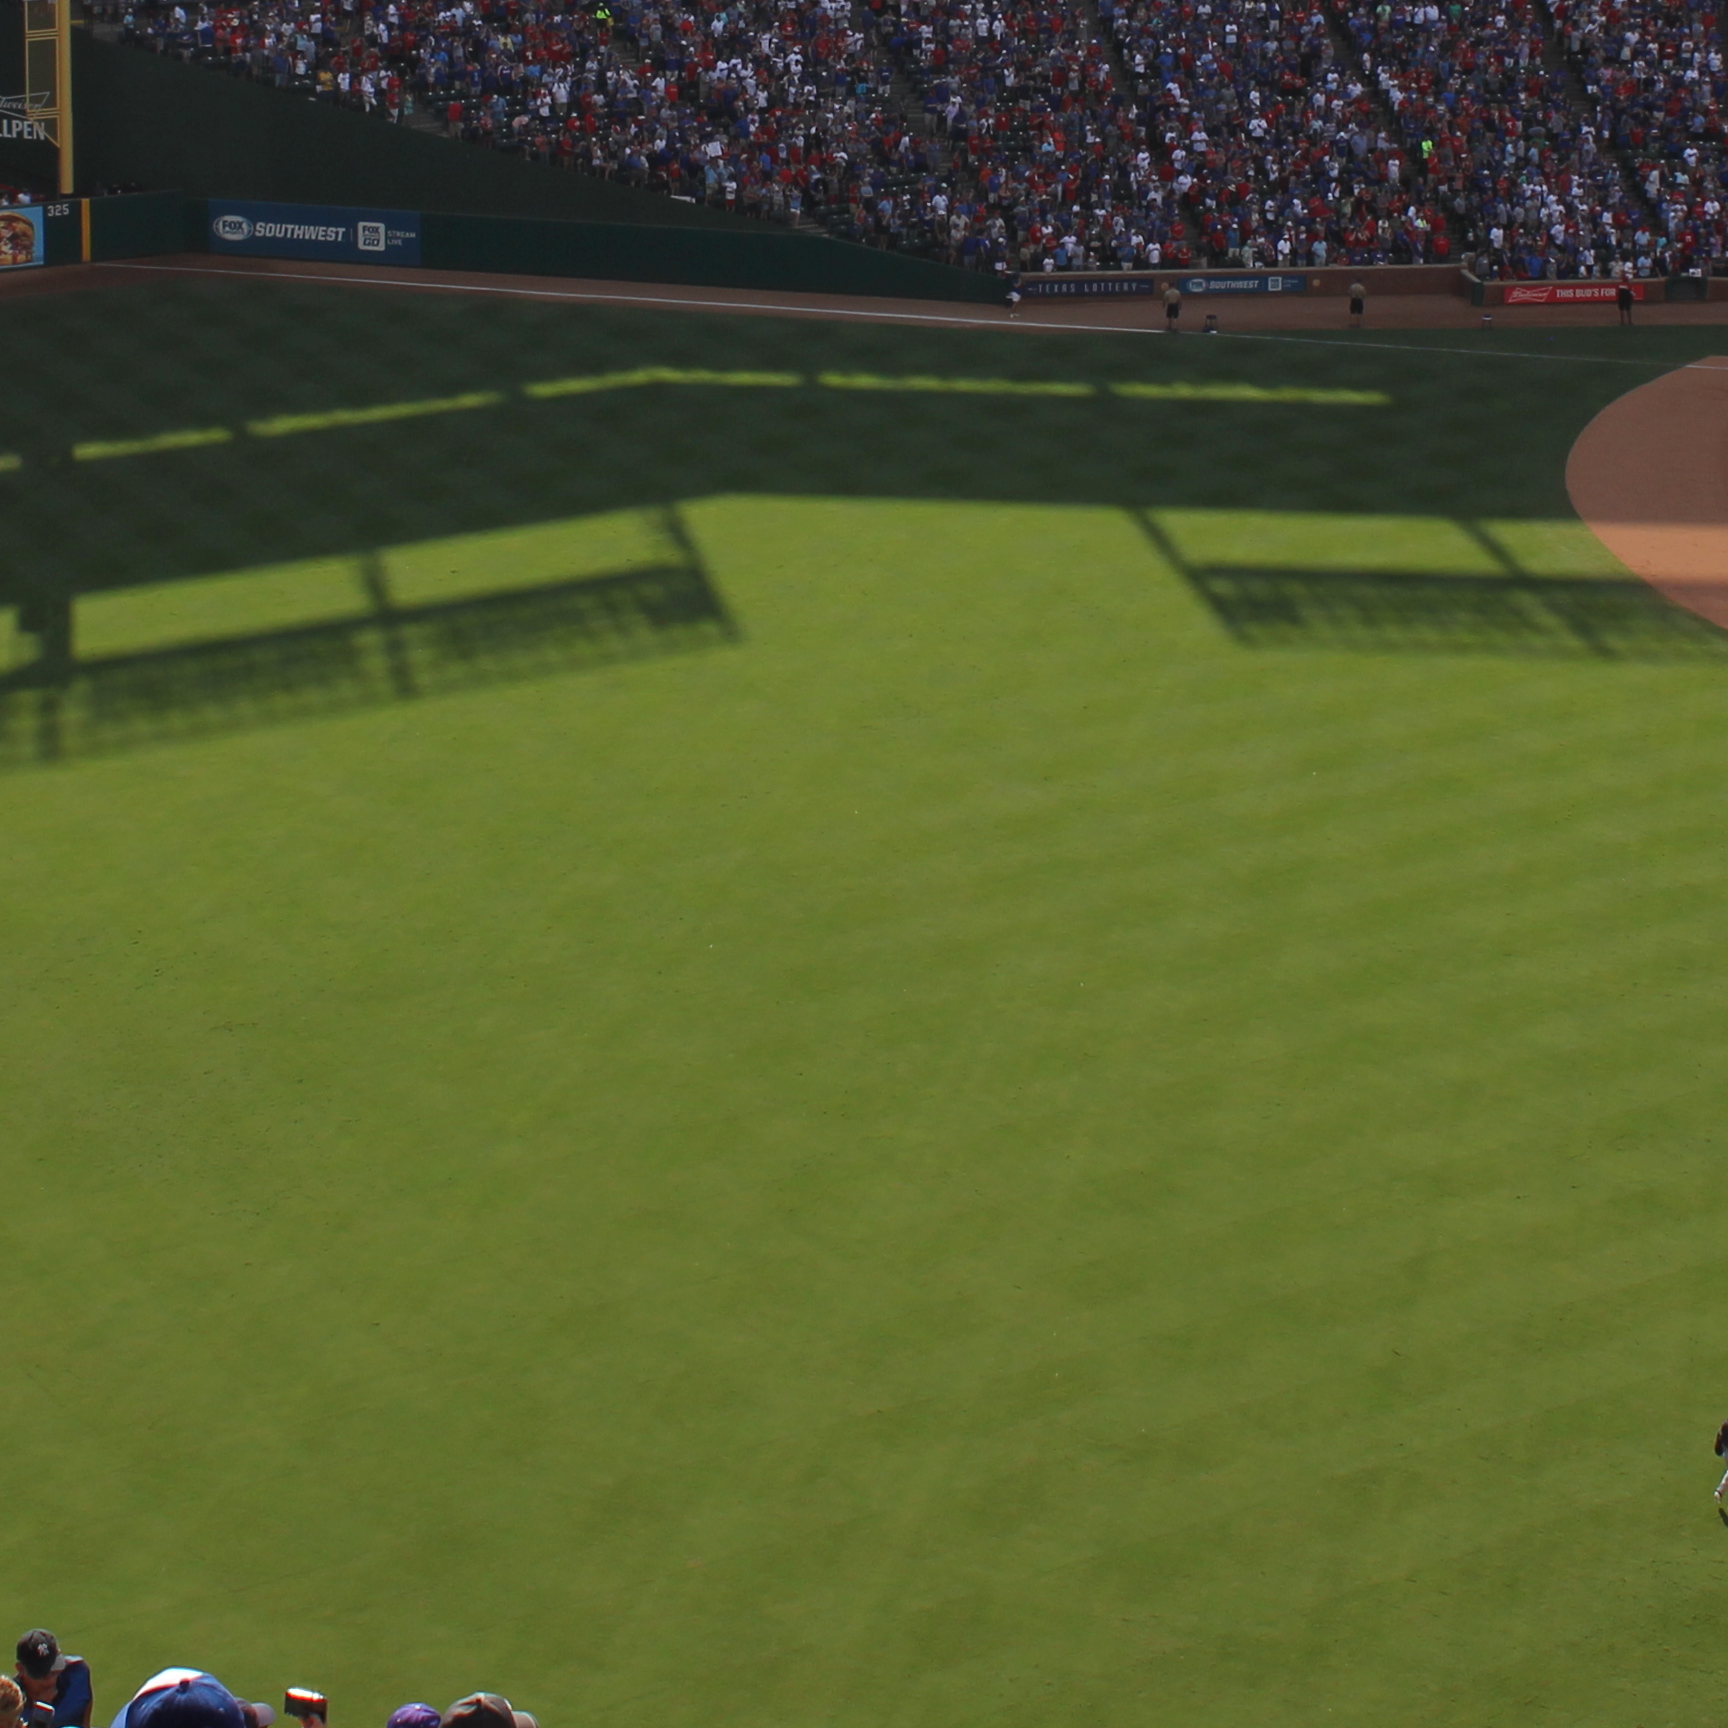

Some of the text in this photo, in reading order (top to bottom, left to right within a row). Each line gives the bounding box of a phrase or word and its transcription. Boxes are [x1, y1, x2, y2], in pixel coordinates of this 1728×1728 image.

[47, 204, 70, 217] 325
[222, 219, 346, 242] FOX SOUTHWEST
[362, 225, 380, 235] FOX
[387, 230, 416, 239] STREAM
[1038, 282, 1137, 293] TEXAS LOTTERY
[1209, 280, 1260, 290] SOUTHWEST
[1556, 289, 1575, 298] THIS
[1600, 287, 1617, 297] FOR
